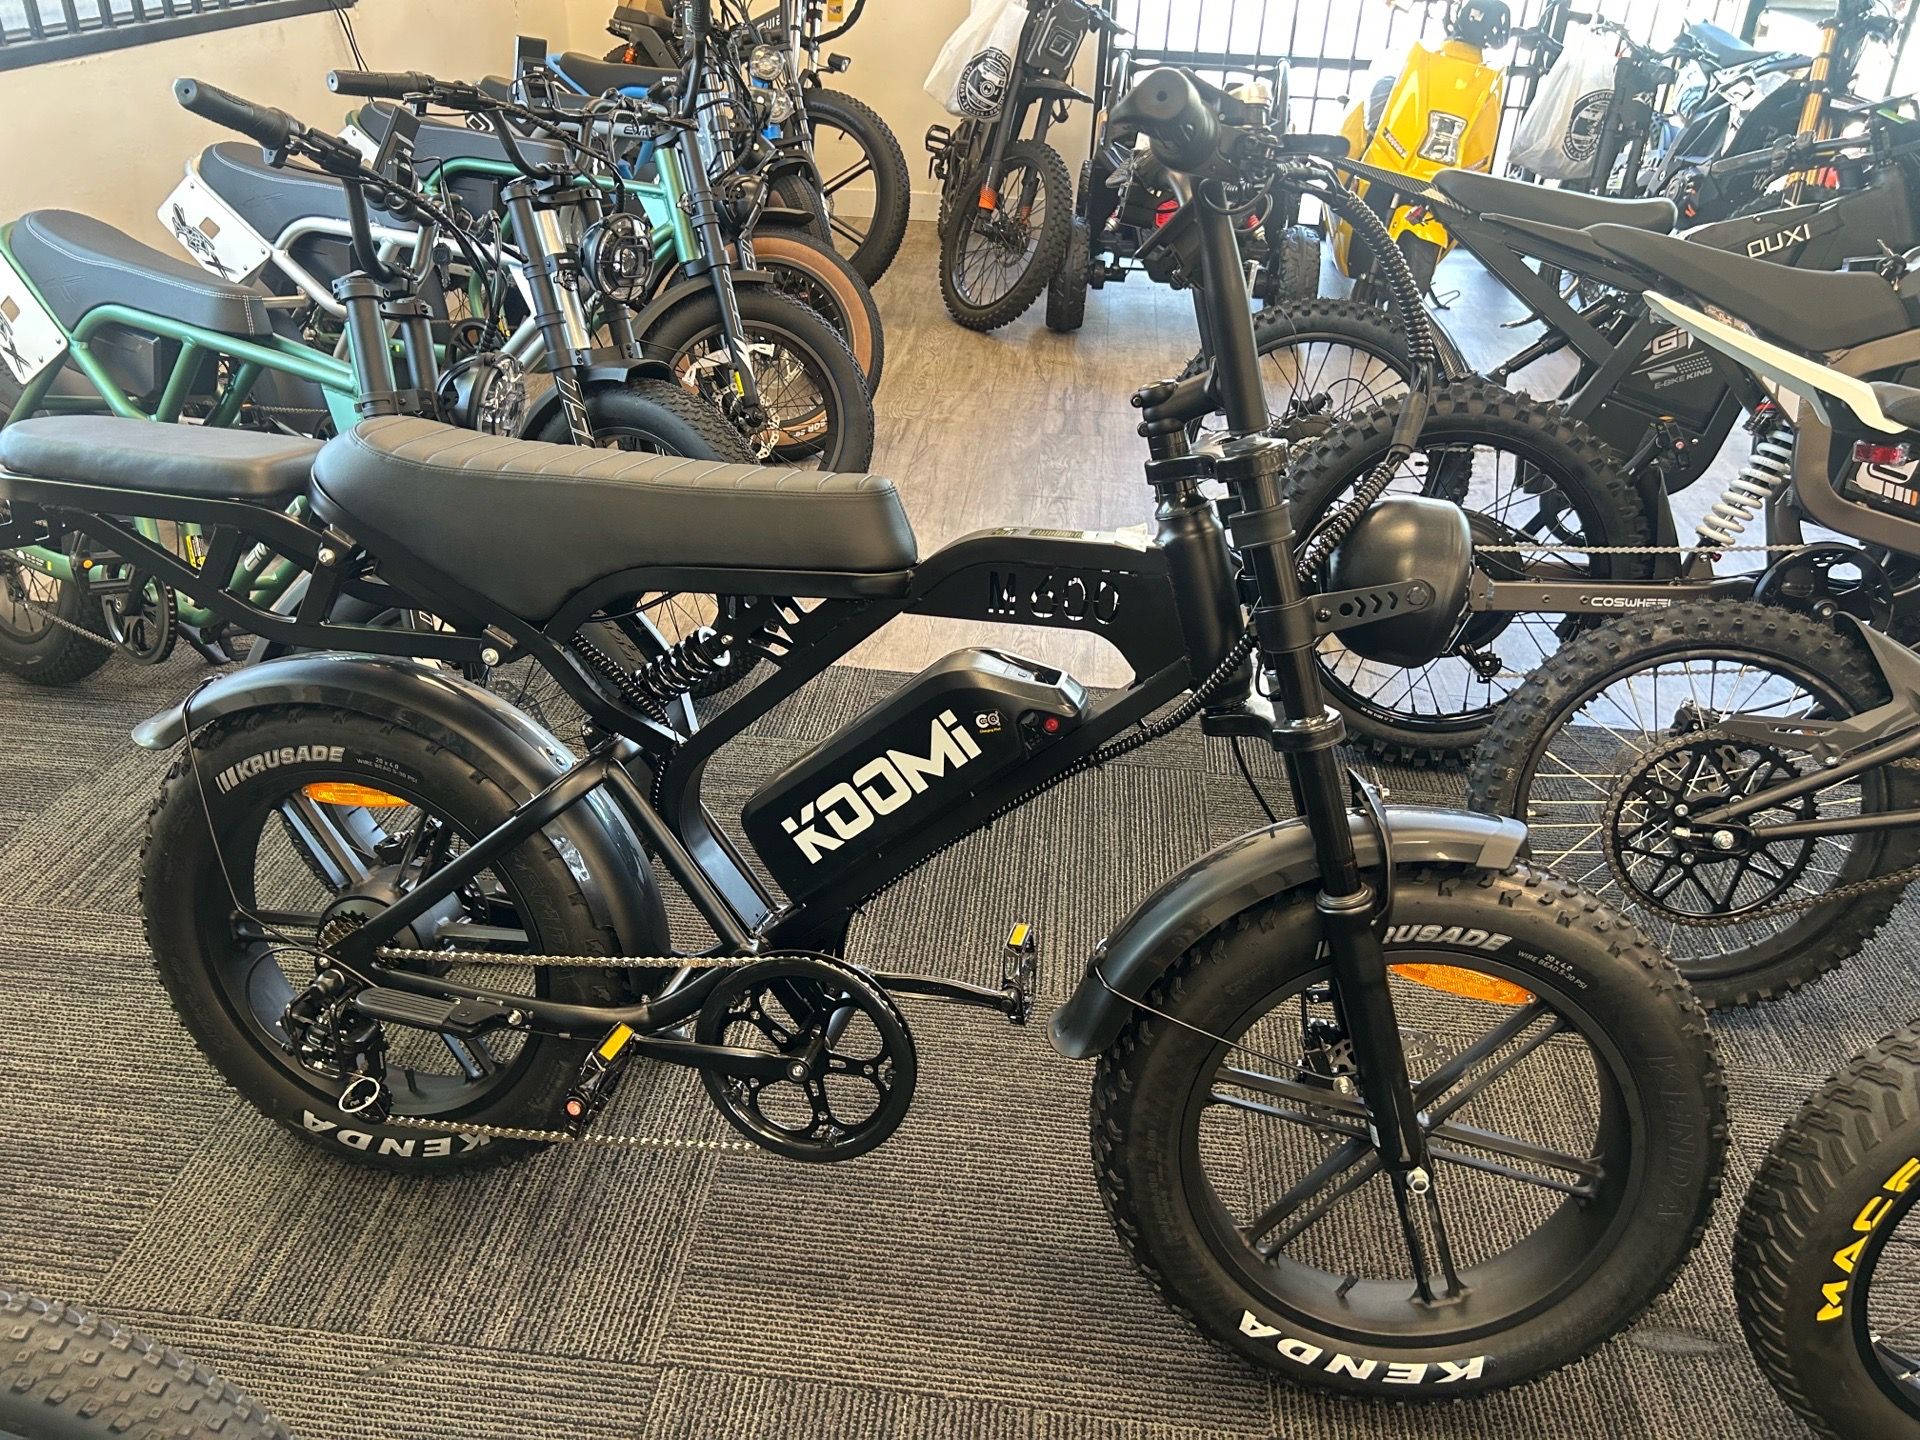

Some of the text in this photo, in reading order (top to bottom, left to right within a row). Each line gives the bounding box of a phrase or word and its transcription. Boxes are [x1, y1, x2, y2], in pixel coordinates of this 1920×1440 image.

[1685, 366, 1714, 381] KING
[234, 744, 346, 783] KRUSADE
[1517, 950, 1539, 963] WIRE
[1537, 959, 1560, 973] BEAD
[1573, 978, 1589, 990] PSI
[1544, 953, 1556, 963] 20
[303, 1109, 492, 1158] KENDA
[1238, 1309, 1486, 1386] KENDA
